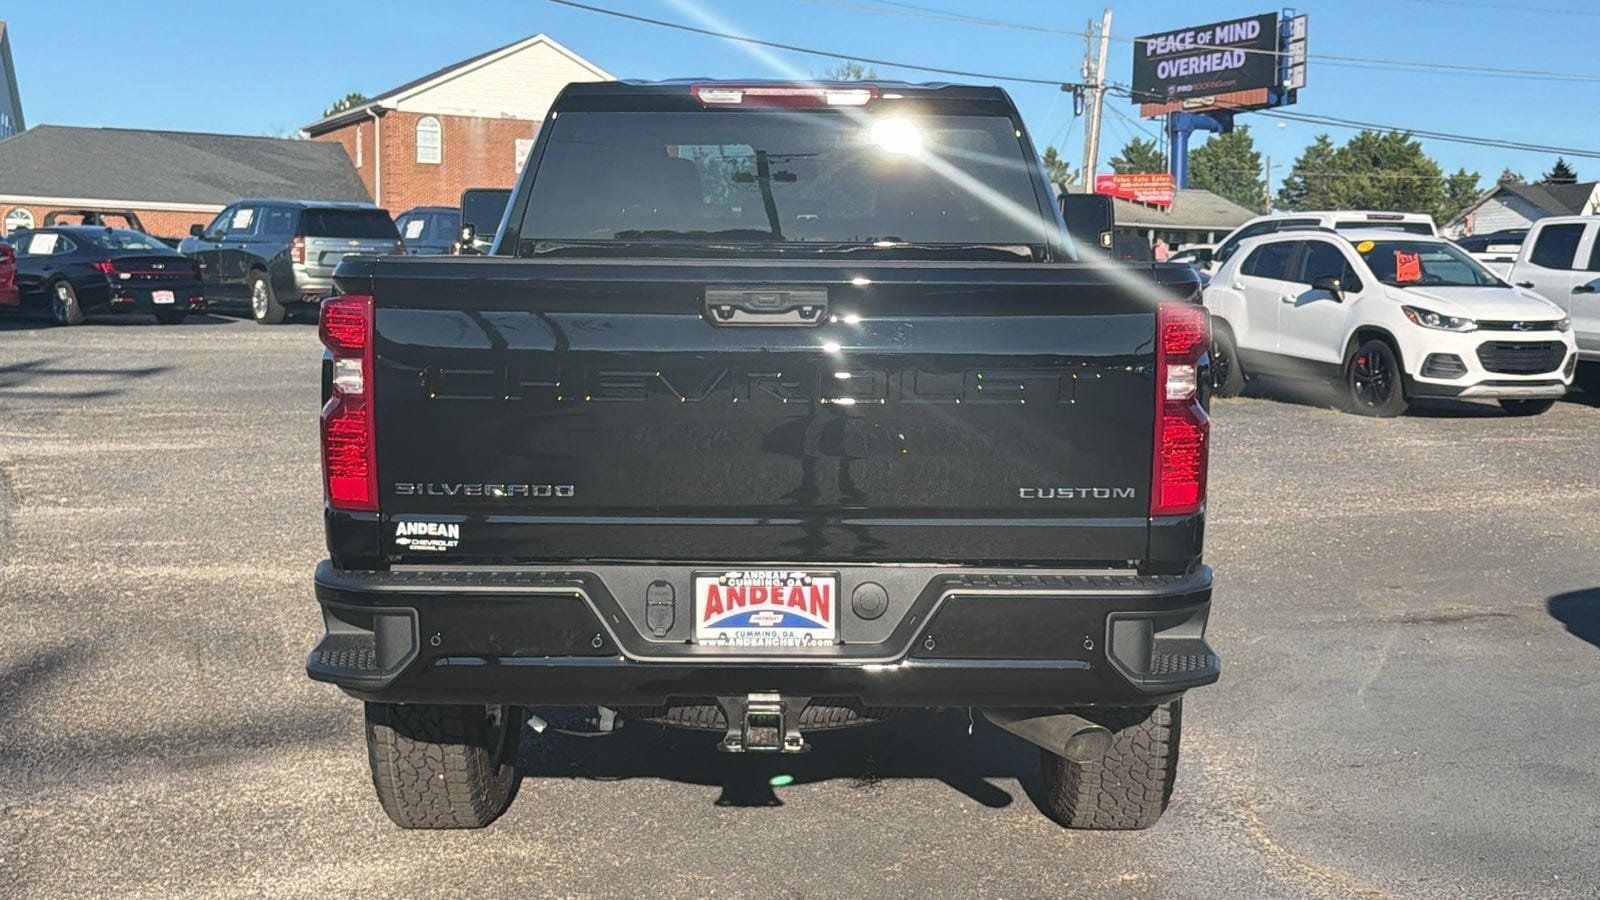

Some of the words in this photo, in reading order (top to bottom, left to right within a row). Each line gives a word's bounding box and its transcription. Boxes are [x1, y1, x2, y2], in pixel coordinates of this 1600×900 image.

[1146, 31, 1195, 56] PEACE
[1197, 31, 1212, 45] OF
[1215, 20, 1260, 45] MIND
[1157, 49, 1246, 79] OVERHEAD
[419, 366, 1105, 405] CHEVROLET
[394, 483, 575, 497] SILVERADO
[1019, 488, 1136, 498] CUSTOM
[395, 522, 460, 539] ANDEAN
[703, 584, 830, 623] ANDEAN
